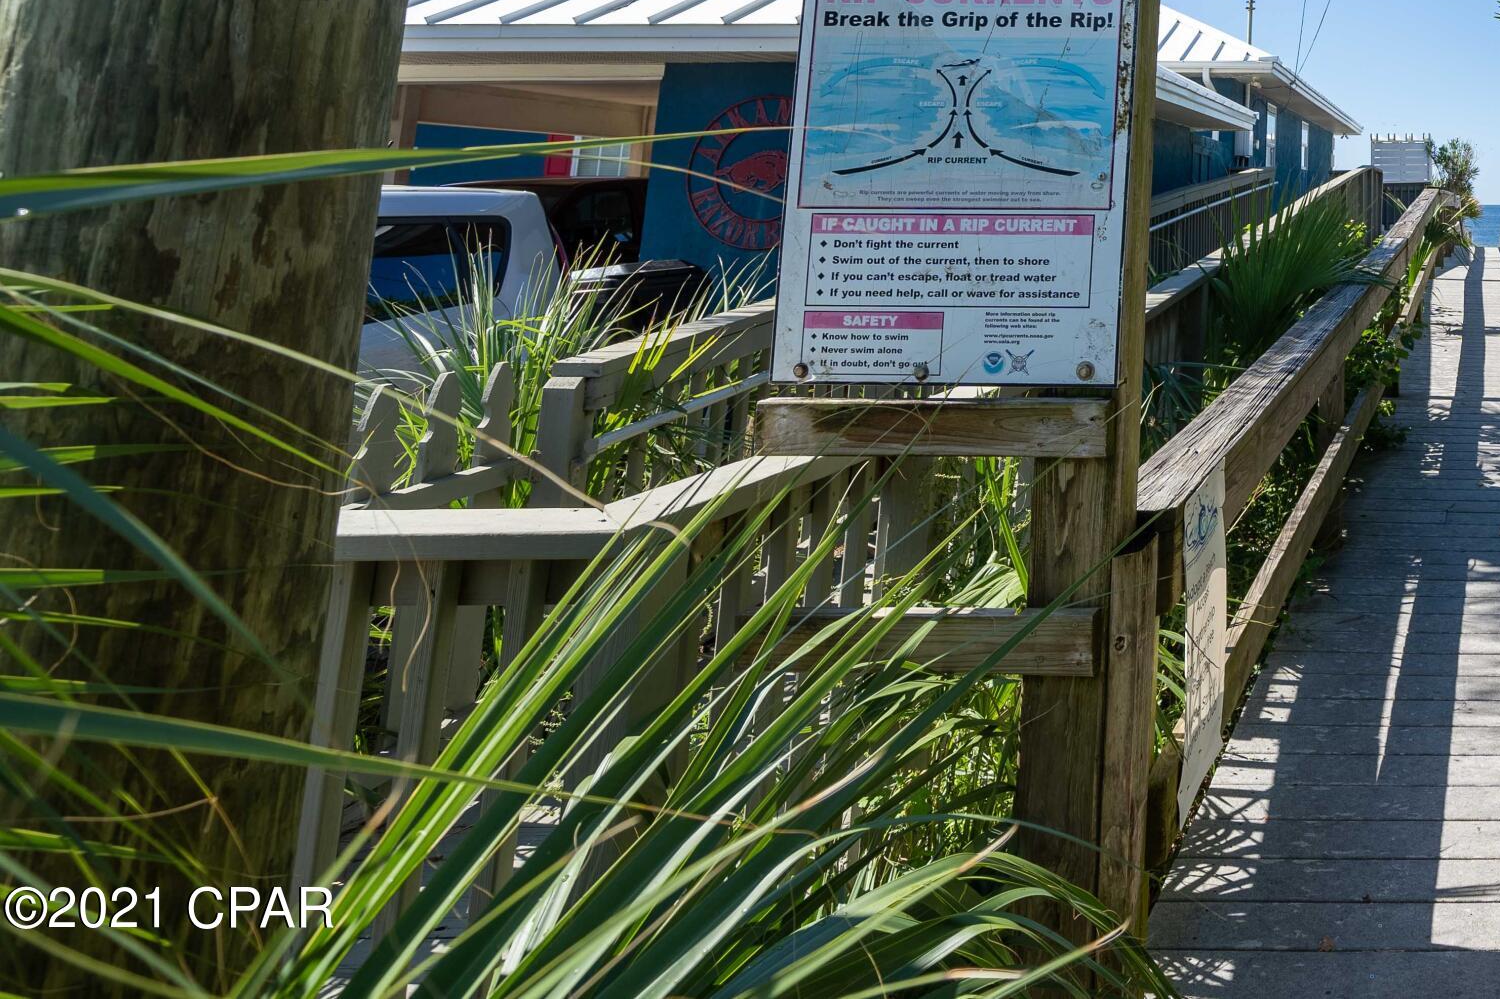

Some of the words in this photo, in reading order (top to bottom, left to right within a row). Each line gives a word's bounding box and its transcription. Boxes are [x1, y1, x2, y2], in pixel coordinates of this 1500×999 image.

[823, 10, 889, 26] Break
[897, 11, 933, 27] the
[941, 11, 988, 31] Grip
[993, 11, 1018, 27] of
[1025, 12, 1062, 27] the
[1070, 12, 1112, 32] Rip!
[821, 217, 837, 231] IF
[842, 217, 913, 231] CAUGHT
[919, 218, 938, 231] IN
[943, 218, 955, 231] A
[959, 218, 989, 232] RIP
[994, 218, 1078, 233] CURRENT
[833, 239, 862, 248] Don't
[866, 239, 891, 250] fight
[895, 239, 913, 248] the
[917, 240, 959, 248] current
[832, 255, 862, 264] Swim
[866, 256, 884, 264] out
[888, 255, 900, 264] of
[903, 256, 921, 264] the
[925, 256, 970, 267] current,
[974, 256, 999, 265] then
[1003, 257, 1014, 265] to
[1018, 256, 1049, 265] shore
[831, 271, 839, 280] If
[842, 273, 862, 282] you
[866, 272, 894, 280] can't
[897, 272, 941, 283] escape,
[945, 271, 971, 281] float
[974, 274, 986, 283] or
[990, 272, 1019, 282] tread
[1023, 273, 1056, 282] water
[830, 288, 838, 296] If
[841, 290, 861, 299] you
[865, 288, 892, 297] need
[896, 288, 923, 299] help,
[927, 288, 947, 297] call
[999, 289, 1015, 297] for
[1018, 289, 1080, 298] assistance
[842, 315, 898, 326] SAFETY
[822, 332, 848, 340] Know
[877, 346, 902, 354] alone
[820, 359, 827, 370] If
[828, 359, 838, 370] in
[840, 359, 870, 368] doubt,
[872, 359, 895, 367] don't
[898, 361, 909, 369] go
